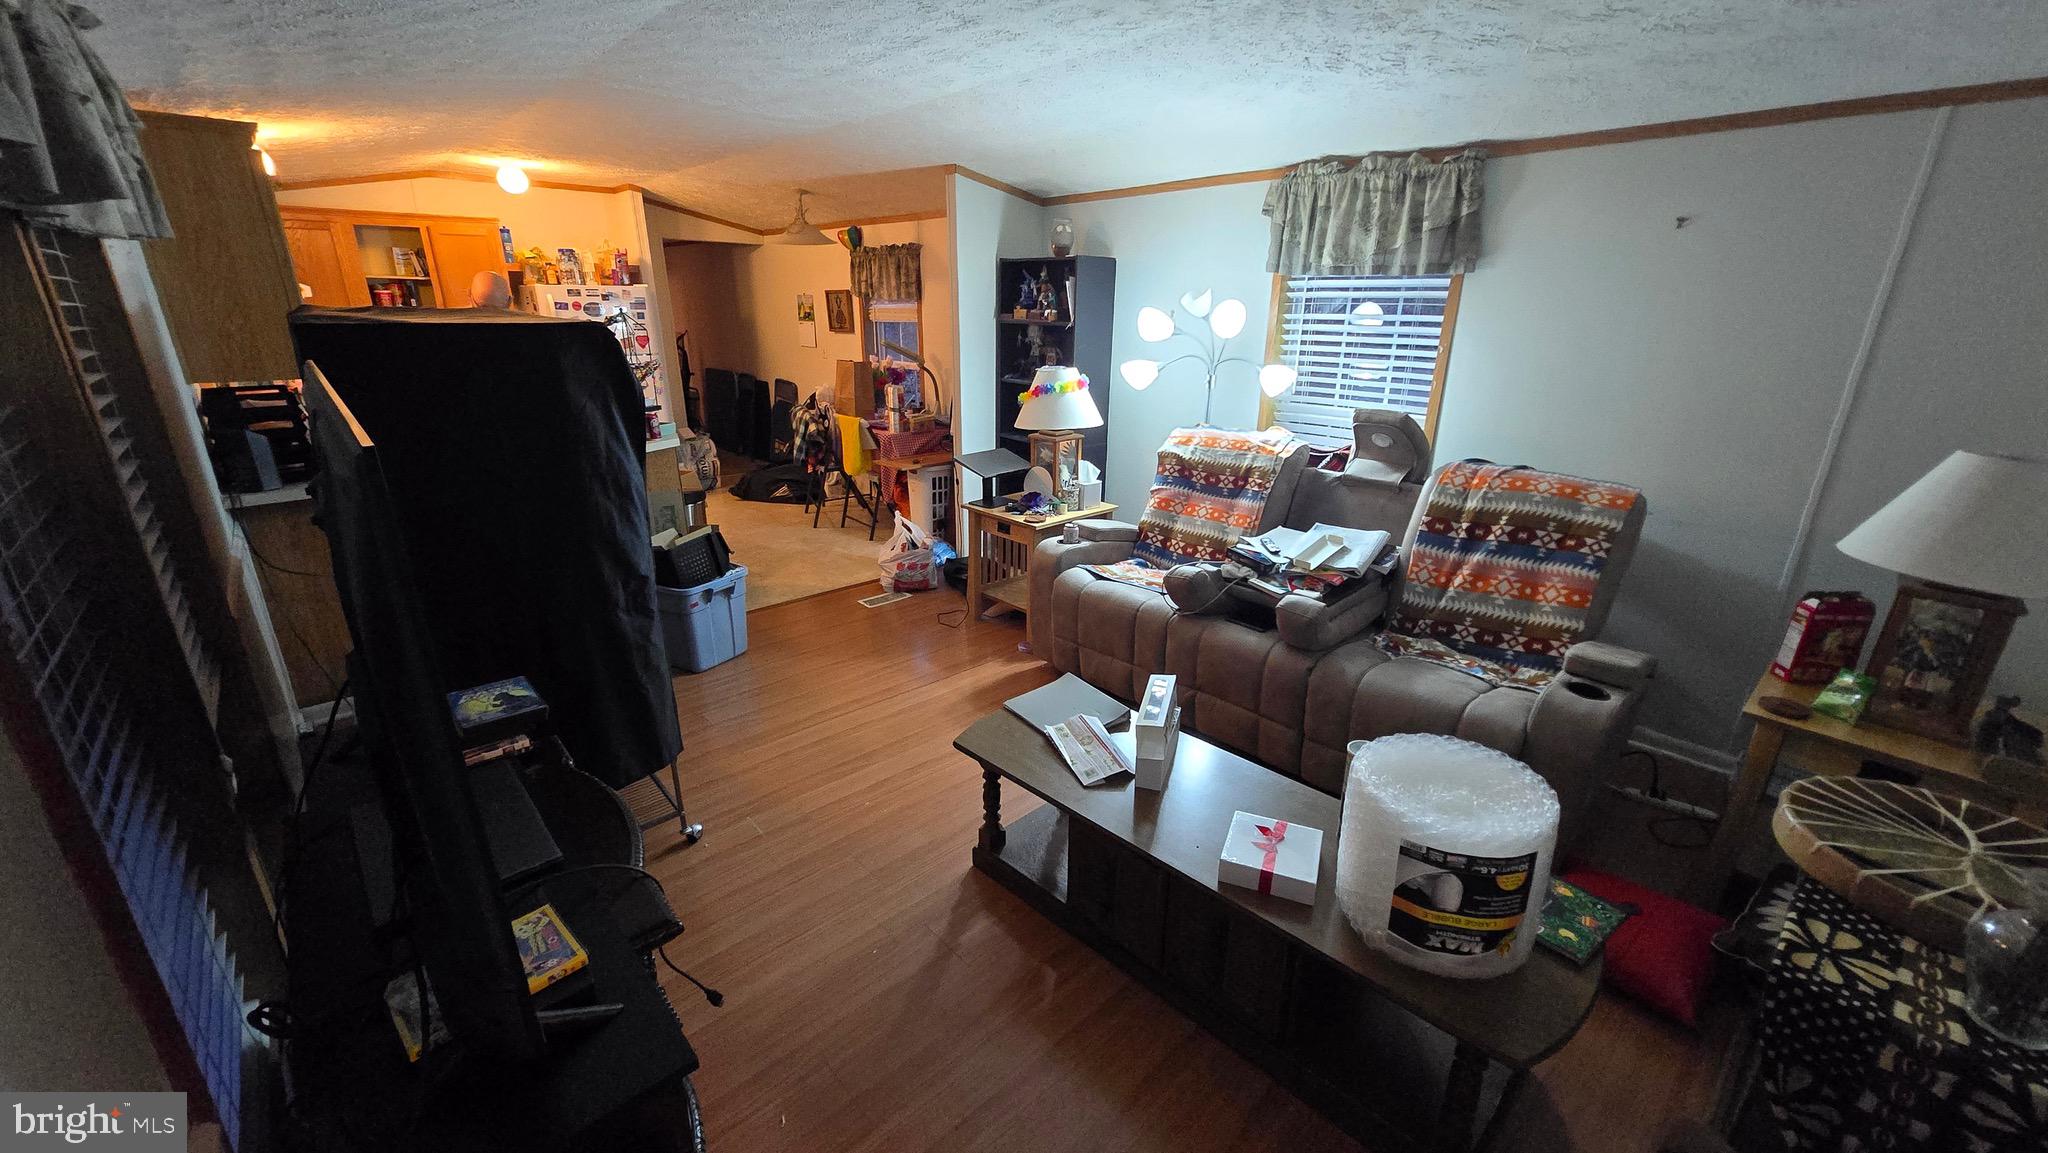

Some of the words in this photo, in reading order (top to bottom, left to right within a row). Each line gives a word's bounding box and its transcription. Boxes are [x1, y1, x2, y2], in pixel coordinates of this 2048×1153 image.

[1422, 911, 1462, 926] BUBBLE
[1465, 919, 1498, 928] LARGE
[1425, 934, 1483, 954] MAX
